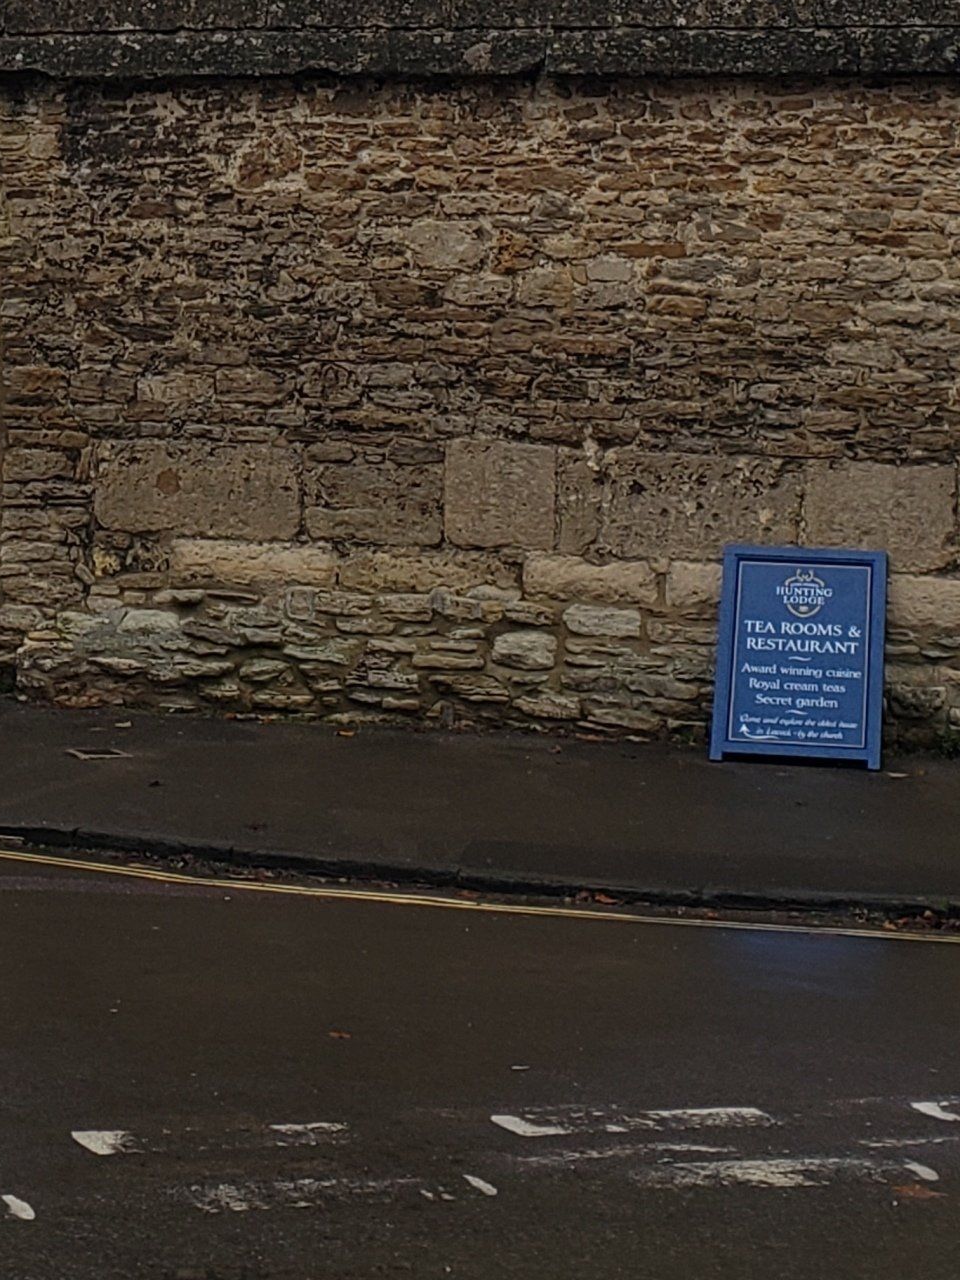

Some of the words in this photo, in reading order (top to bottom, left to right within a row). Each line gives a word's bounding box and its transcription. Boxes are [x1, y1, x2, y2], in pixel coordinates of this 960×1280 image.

[776, 586, 833, 597] HUNTING
[783, 595, 825, 605] LODGE
[744, 620, 776, 634] TEA
[781, 622, 842, 636] ROOMS
[848, 625, 861, 638] &
[746, 637, 859, 654] RESTAURANT
[741, 662, 777, 674] Award
[780, 664, 822, 678] winning
[825, 667, 862, 679] cuisine
[749, 677, 780, 690] Royal
[783, 682, 818, 692] cream
[822, 683, 846, 693] teas
[755, 693, 792, 705] Secret
[795, 696, 838, 708] garden
